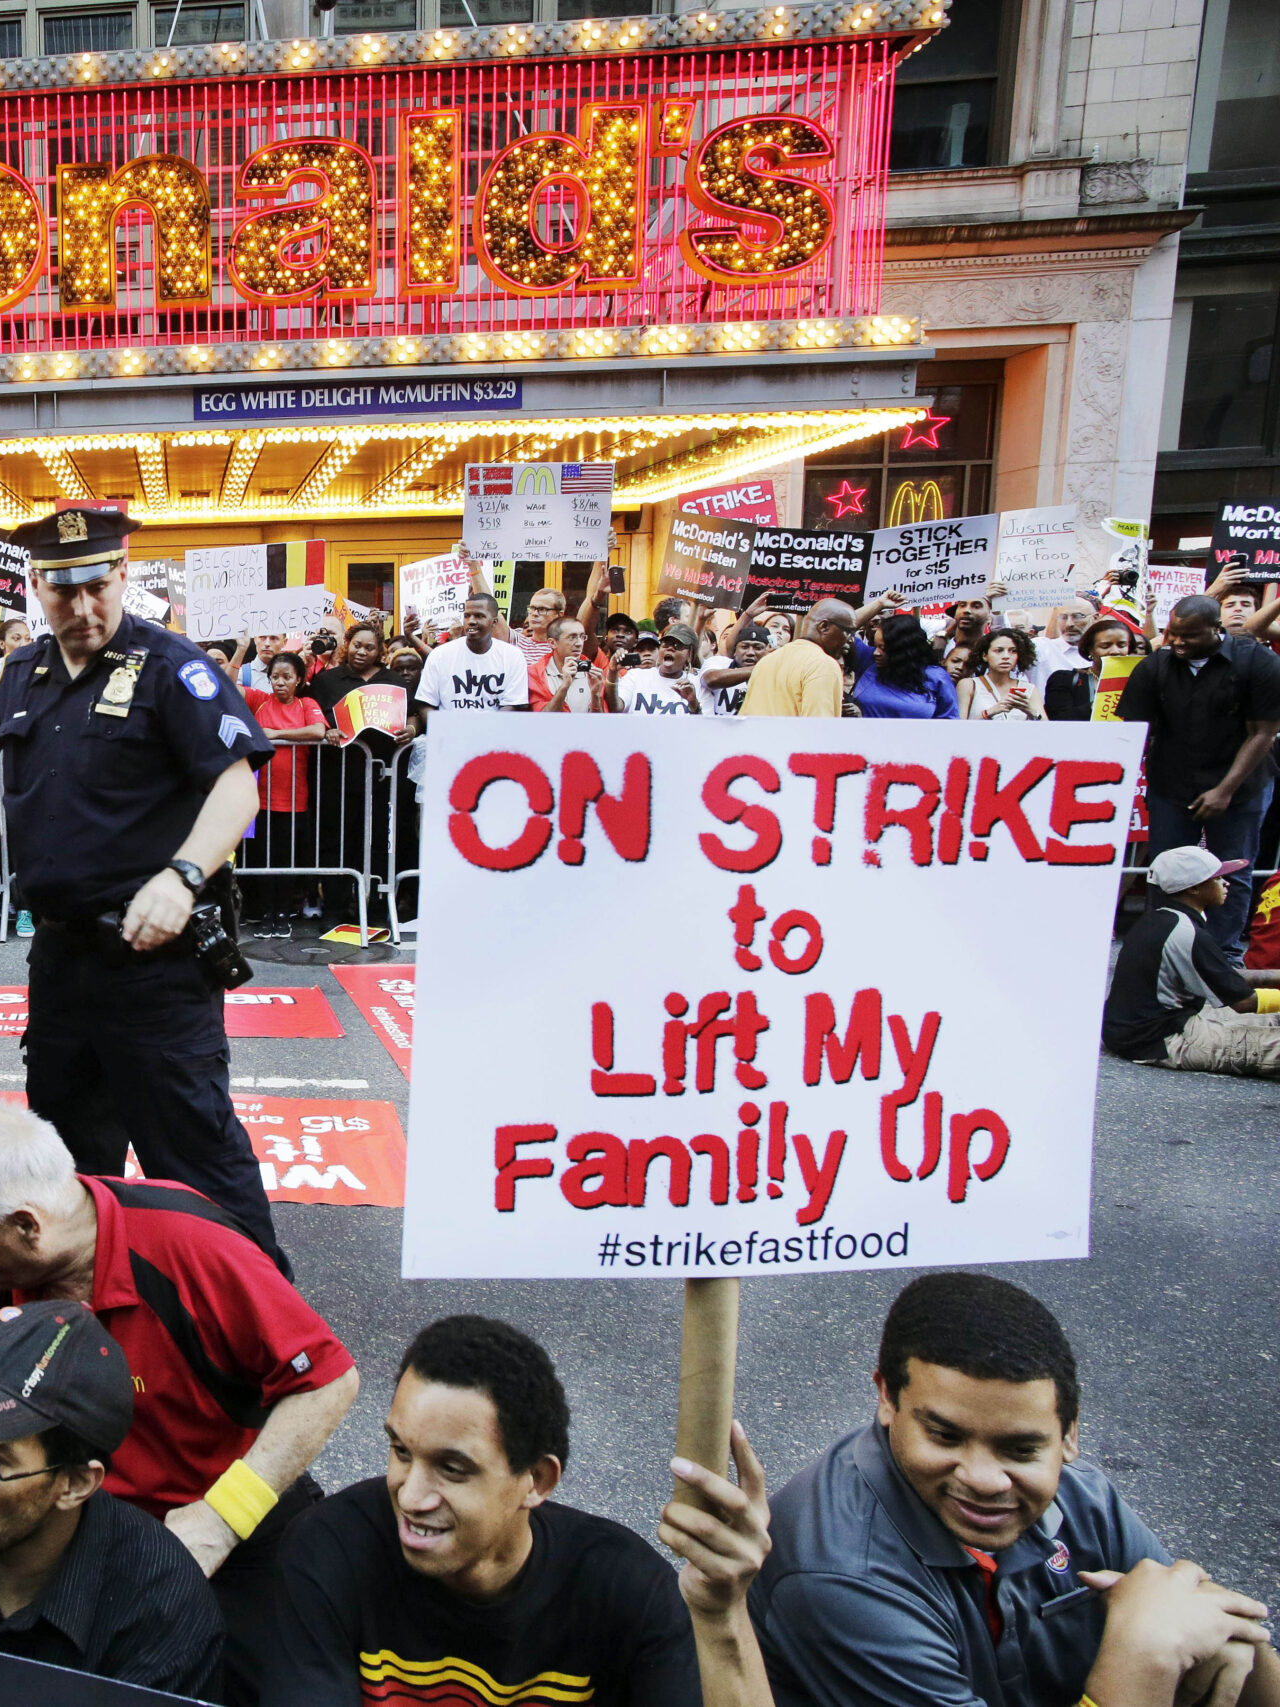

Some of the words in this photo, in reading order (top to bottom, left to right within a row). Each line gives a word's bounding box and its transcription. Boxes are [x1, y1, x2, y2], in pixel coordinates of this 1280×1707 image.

[201, 393, 236, 412] EGG
[240, 389, 296, 410] WHITE
[301, 387, 374, 408] DELIGHT
[378, 382, 470, 405] McMUFFIN
[473, 380, 517, 401] $3.29
[571, 498, 600, 511] $8/HR
[672, 519, 750, 553] McDonald's
[900, 523, 963, 546] STICK
[1006, 519, 1075, 535] JUSTICE
[1118, 524, 1140, 533] MAKE
[480, 540, 498, 549] YES
[575, 540, 589, 548] NO
[754, 532, 864, 553] McDonald's
[1022, 537, 1045, 546] FOR
[192, 549, 259, 571] BELGIUM
[545, 552, 568, 560] RIGHT
[674, 540, 701, 560] Won't
[701, 548, 737, 568] Listen
[873, 538, 988, 565] TOGETHER
[999, 552, 1028, 564] FAST
[1035, 547, 1070, 560] FOOD
[0, 558, 27, 577] Liste
[751, 552, 776, 568] No
[780, 553, 862, 572] Escucha
[214, 567, 264, 589] WORKERS
[665, 563, 681, 580] We
[684, 566, 714, 587] Must
[717, 573, 743, 593] Act
[906, 568, 922, 578] for
[1000, 564, 1075, 583] WORKERS!
[1149, 569, 1203, 584] WHATEVER
[747, 574, 800, 588] Nosotros
[803, 578, 860, 593] Tenemos
[893, 581, 933, 595] Union
[937, 573, 986, 590] Rights
[1153, 582, 1161, 593] IT
[1167, 582, 1197, 595] TAKES
[192, 593, 254, 616] SUPPORT
[448, 601, 465, 613] Rig
[198, 613, 232, 638] US
[239, 606, 321, 636] STRIKERS
[181, 662, 207, 679] POLICE
[362, 694, 393, 704] RAISE
[451, 699, 484, 709] TURN
[1101, 694, 1112, 720] NOT
[364, 709, 388, 718] NEW
[448, 750, 653, 872] ON
[698, 753, 1126, 874] STRIKE
[728, 883, 824, 975] to
[590, 989, 769, 1098] Lift
[804, 987, 942, 1107] My
[299, 1115, 371, 1134] $15
[494, 1101, 848, 1227] Family
[880, 1091, 1011, 1204] Up
[597, 1222, 910, 1269] #strikefastfood
